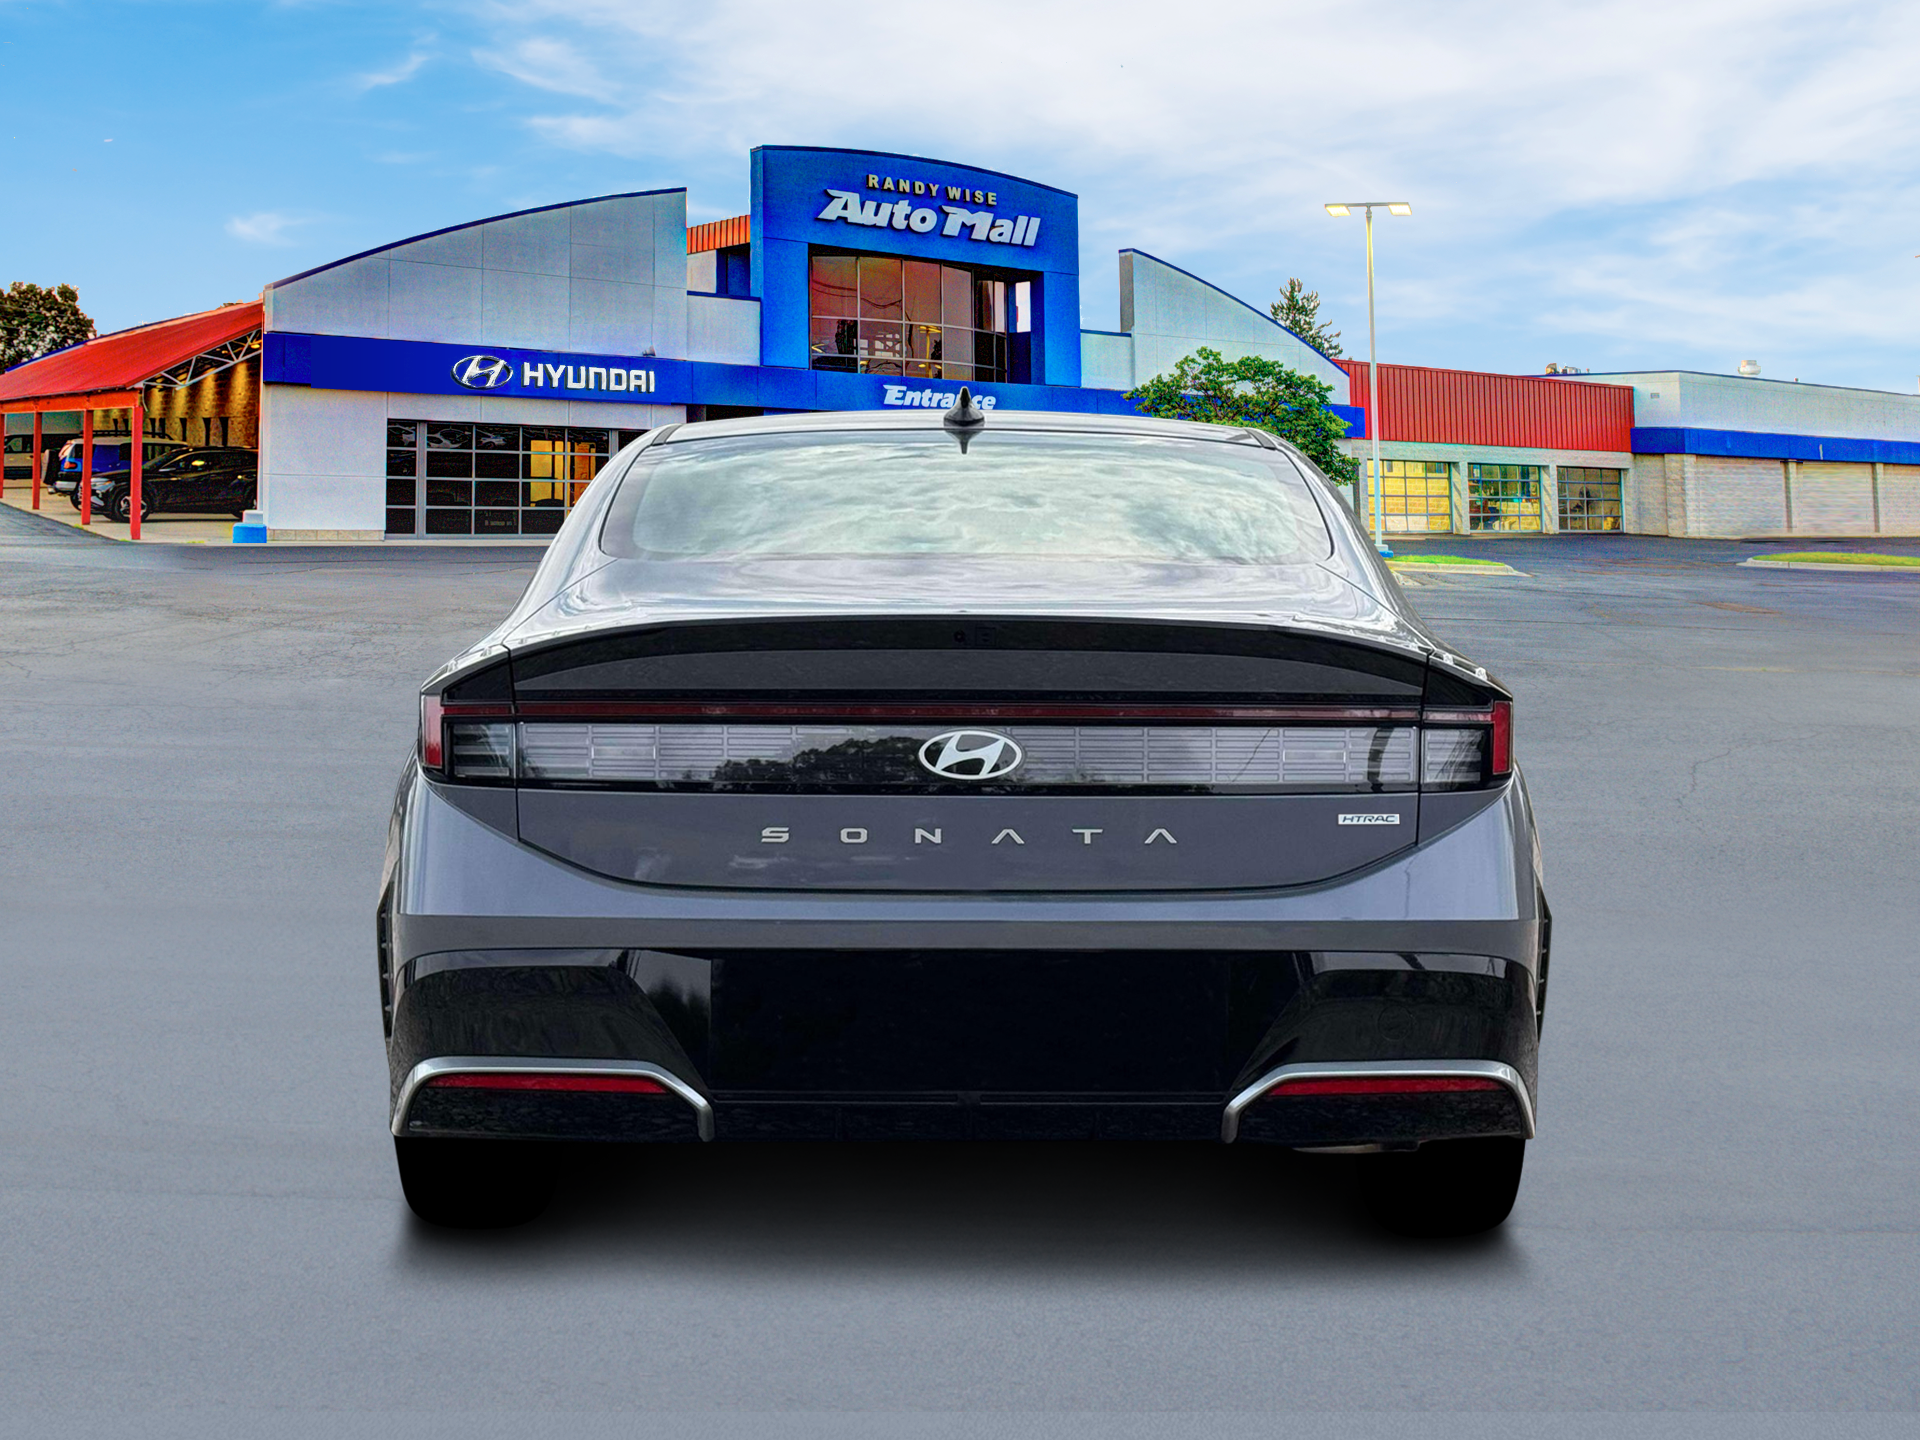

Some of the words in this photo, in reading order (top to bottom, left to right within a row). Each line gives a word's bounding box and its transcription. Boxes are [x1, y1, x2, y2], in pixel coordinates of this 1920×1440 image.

[867, 173, 939, 197] RANDY
[947, 185, 998, 206] WISE
[817, 188, 938, 233] Auto
[941, 204, 1041, 247] Mall
[522, 361, 656, 393] HYUNDAI
[883, 384, 997, 410] Entrace
[1341, 814, 1397, 823] HTRAC
[761, 827, 1178, 844] SONATA
